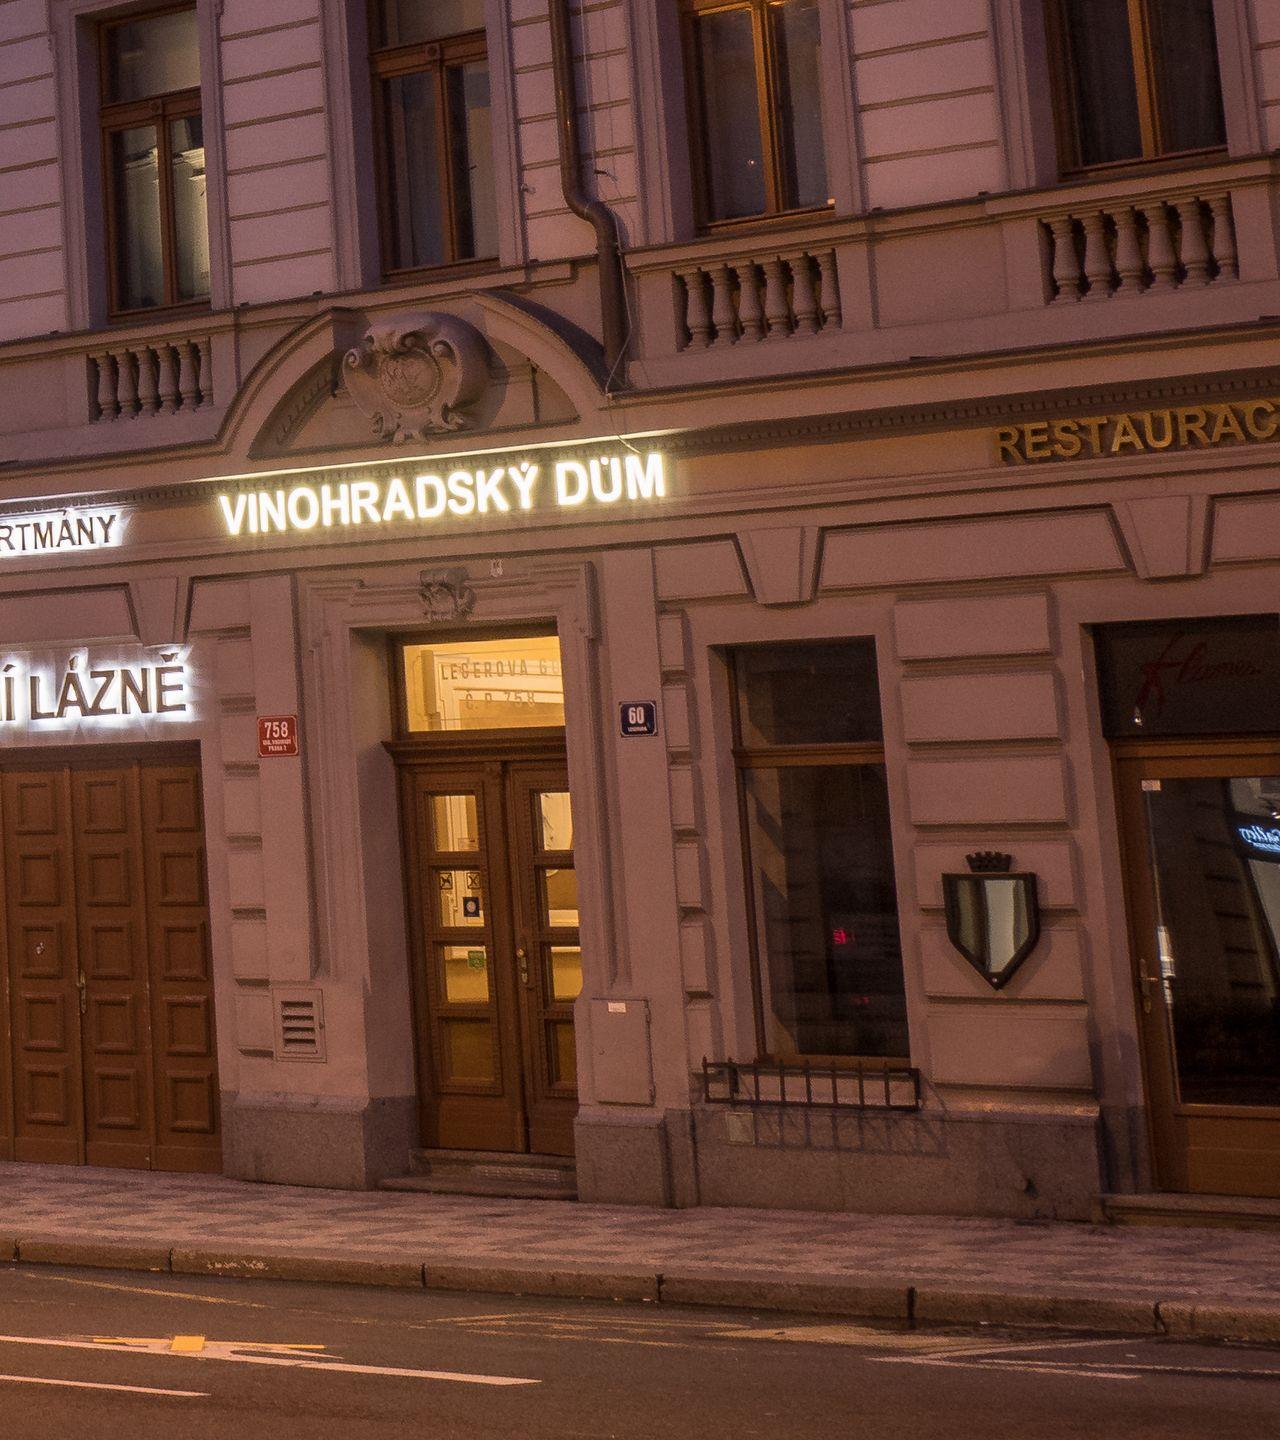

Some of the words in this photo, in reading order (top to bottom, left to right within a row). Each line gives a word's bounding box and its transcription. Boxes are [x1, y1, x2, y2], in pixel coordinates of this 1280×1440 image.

[219, 462, 539, 536] VINOHRADSKÝ
[555, 453, 666, 506] DŮM
[29, 652, 187, 721] LÁZNĚ
[264, 721, 289, 739] 758
[628, 706, 645, 725] 60
